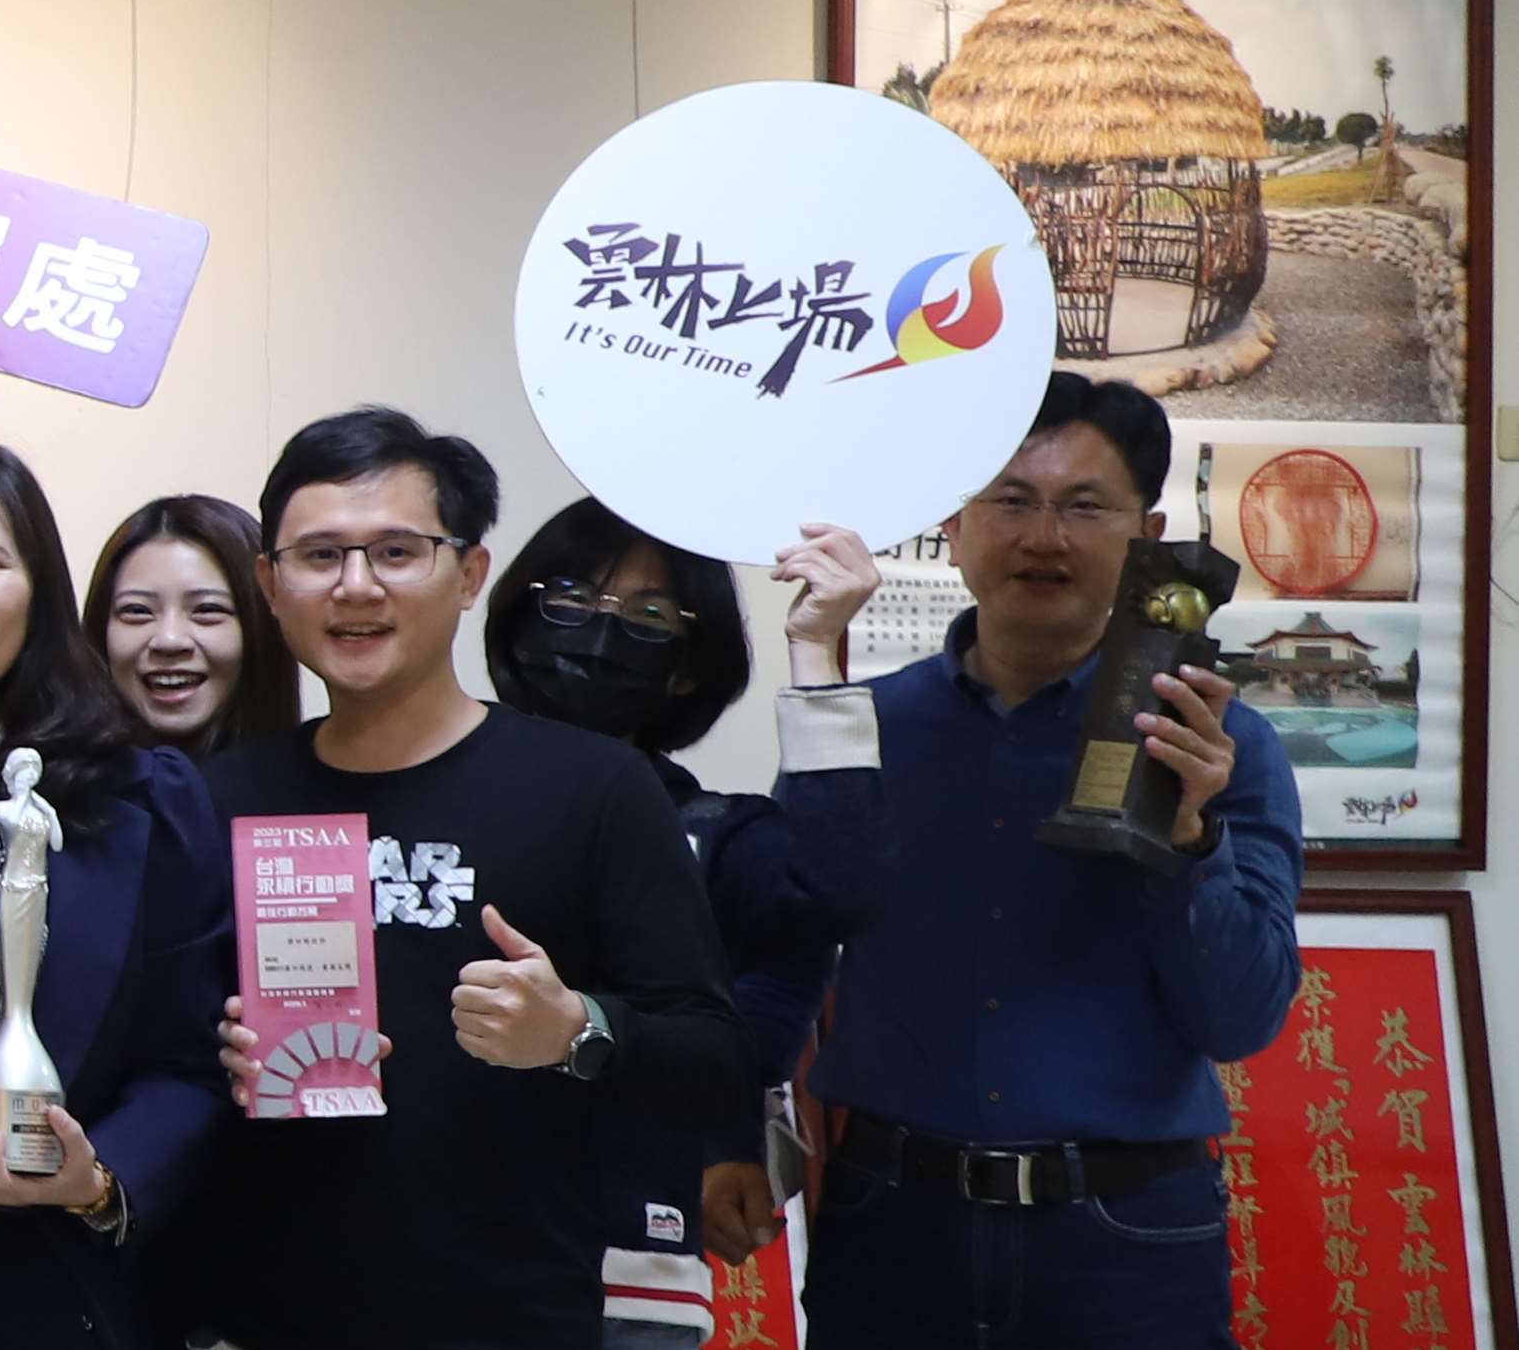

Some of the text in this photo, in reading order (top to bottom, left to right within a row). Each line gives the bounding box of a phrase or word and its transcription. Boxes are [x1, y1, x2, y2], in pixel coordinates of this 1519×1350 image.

[562, 222, 874, 399] 雲林上場
[564, 321, 753, 378] It's Our Time
[283, 827, 351, 847] TSAA
[368, 836, 475, 885] AR
[374, 880, 474, 928] RS
[304, 1091, 382, 1113] TSAA
